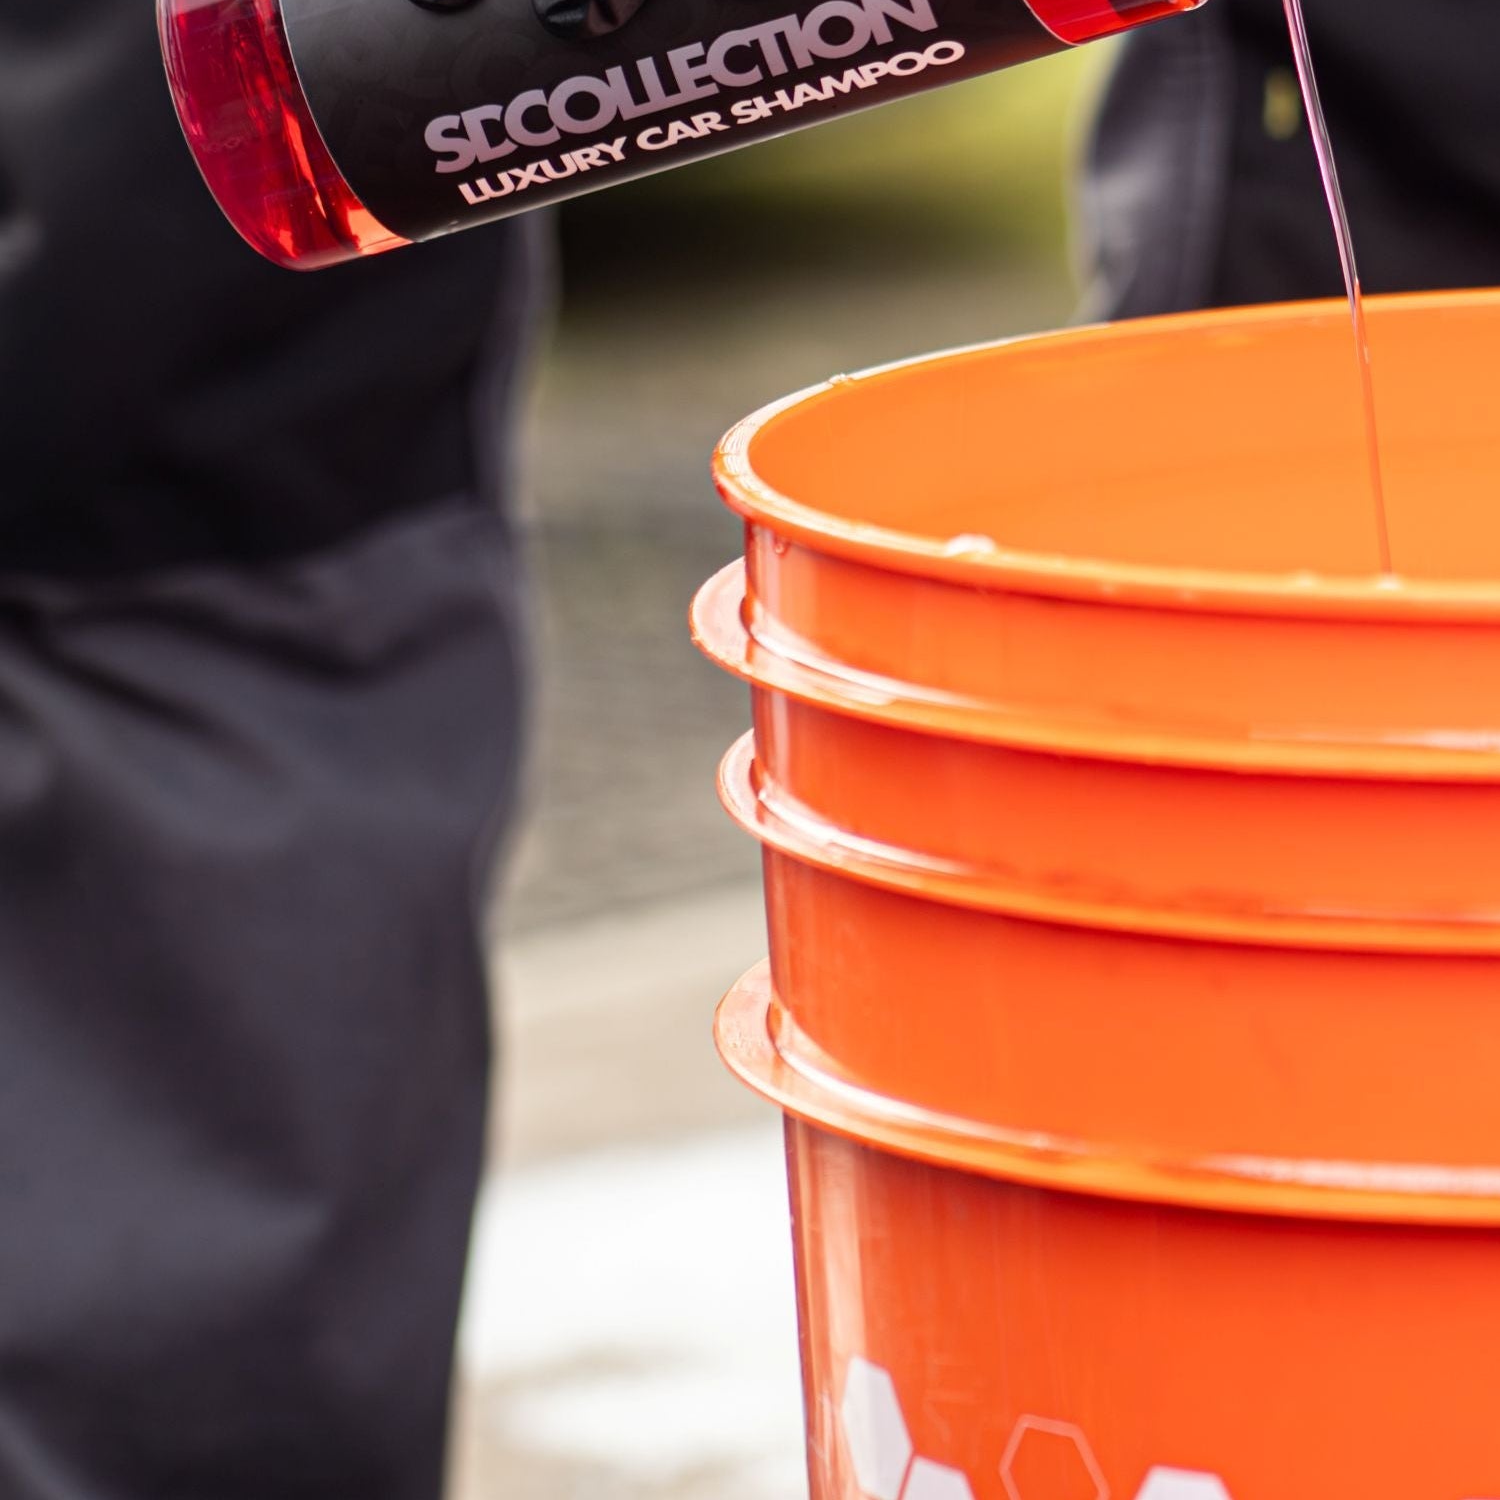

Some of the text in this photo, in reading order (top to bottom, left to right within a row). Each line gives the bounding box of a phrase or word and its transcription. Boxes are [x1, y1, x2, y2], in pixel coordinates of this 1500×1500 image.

[457, 39, 966, 206] LUXURY CAR SHAMPOO
